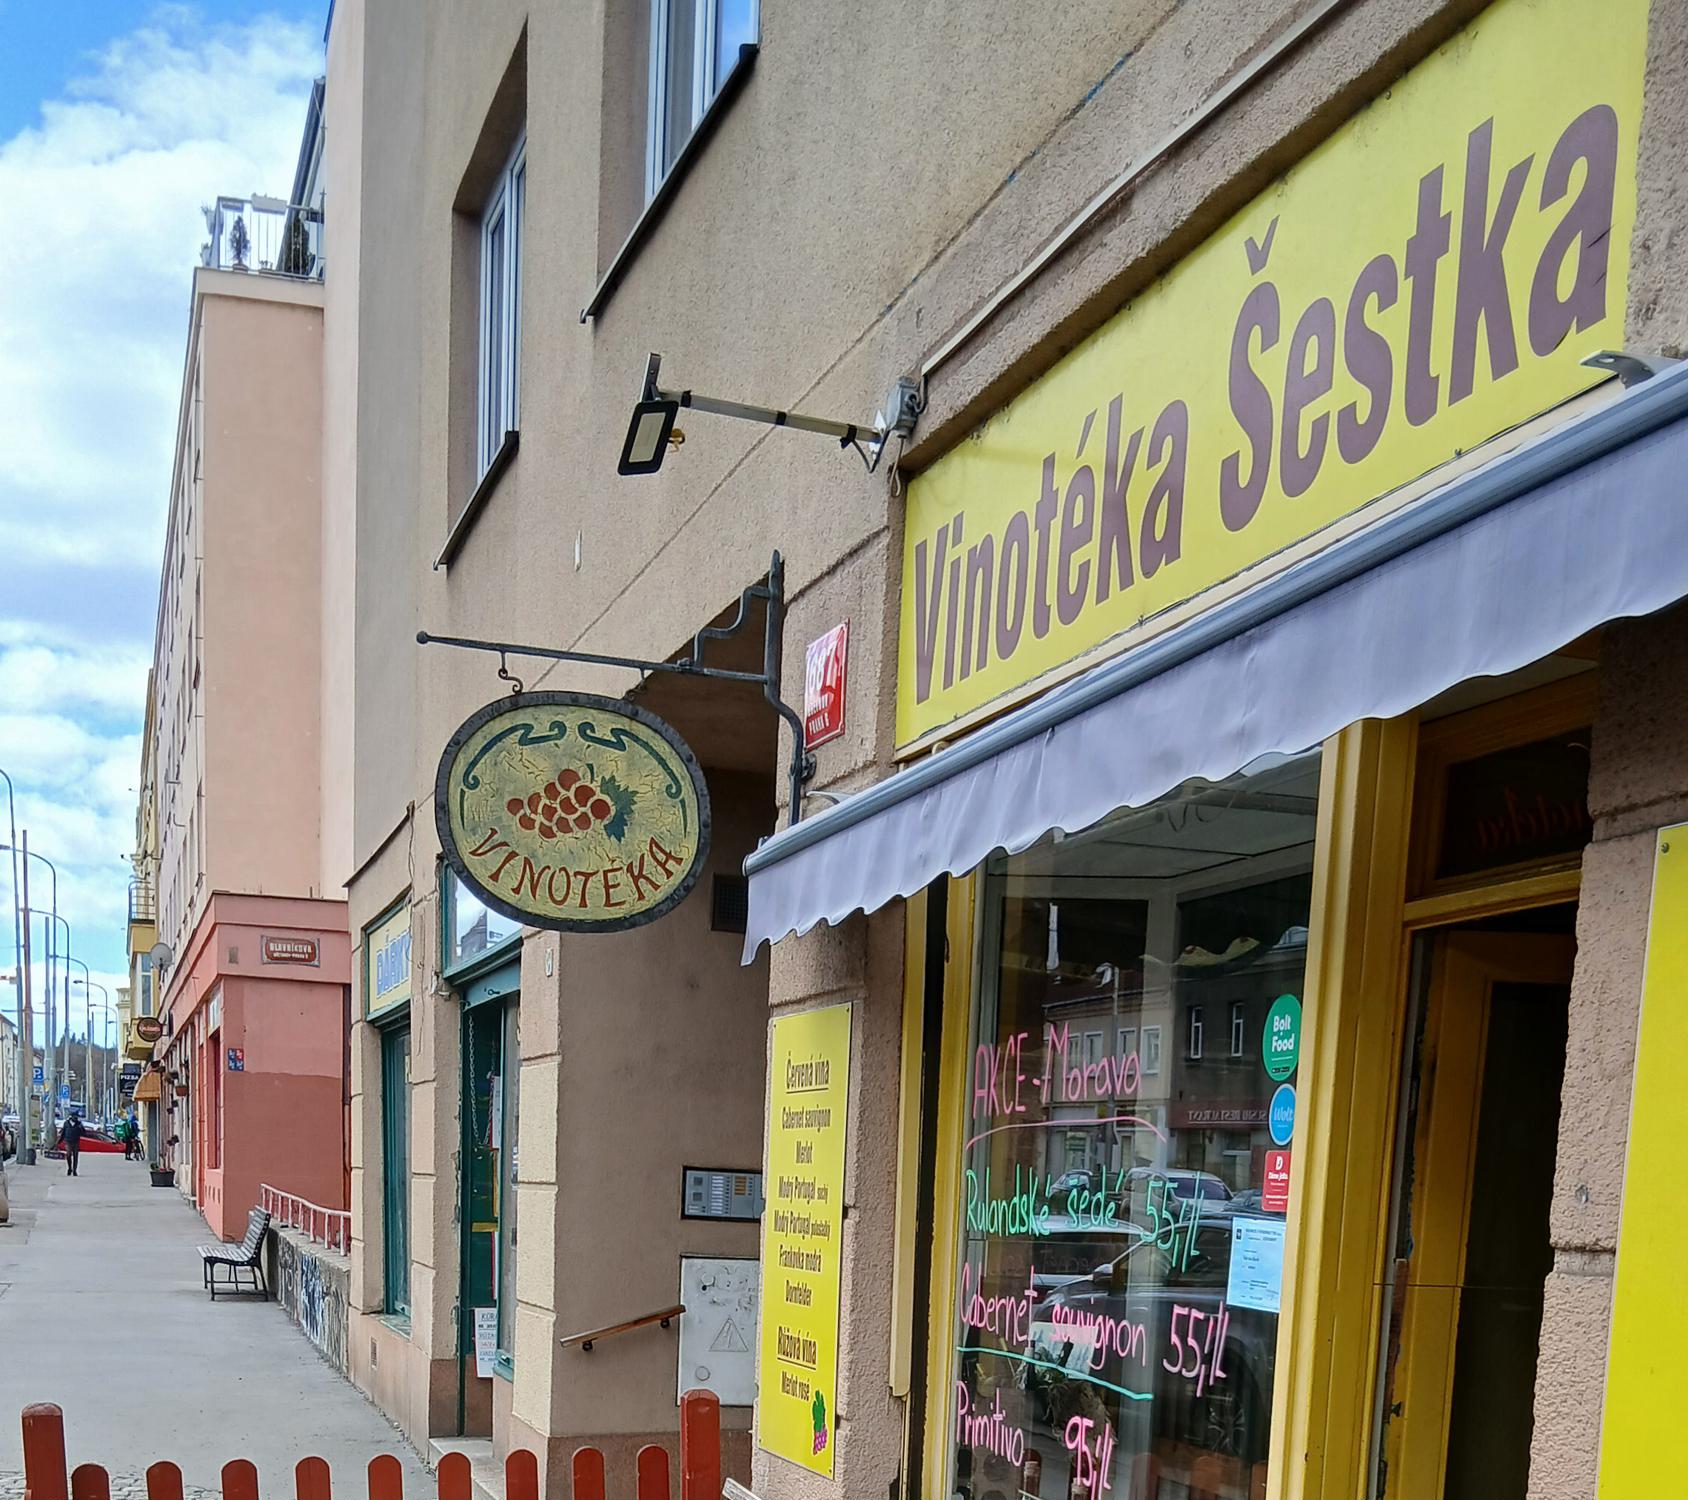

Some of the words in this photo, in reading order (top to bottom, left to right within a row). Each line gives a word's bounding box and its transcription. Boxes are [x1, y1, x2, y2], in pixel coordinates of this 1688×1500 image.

[914, 391, 1190, 706] Vinotéka
[1218, 103, 1619, 534] Šestka
[1273, 1015, 1291, 1032] Bolt
[1272, 1033, 1295, 1052] Food
[786, 1050, 814, 1090] Červená
[814, 1053, 830, 1086] vína
[973, 1032, 1028, 1120] AKCE
[782, 1106, 805, 1130] Cabernet
[1273, 1106, 1293, 1122] Wolt
[796, 1140, 813, 1164] Merlot
[794, 1175, 816, 1205] Portugal
[966, 1163, 1051, 1237] Rulandské
[789, 1209, 811, 1240] Portugal
[779, 1244, 804, 1270] Frankovka
[804, 1248, 822, 1272] modrá
[960, 1261, 1038, 1349] Cabernet
[781, 1370, 799, 1398] Merlot
[956, 1380, 1025, 1467] Primitivo
